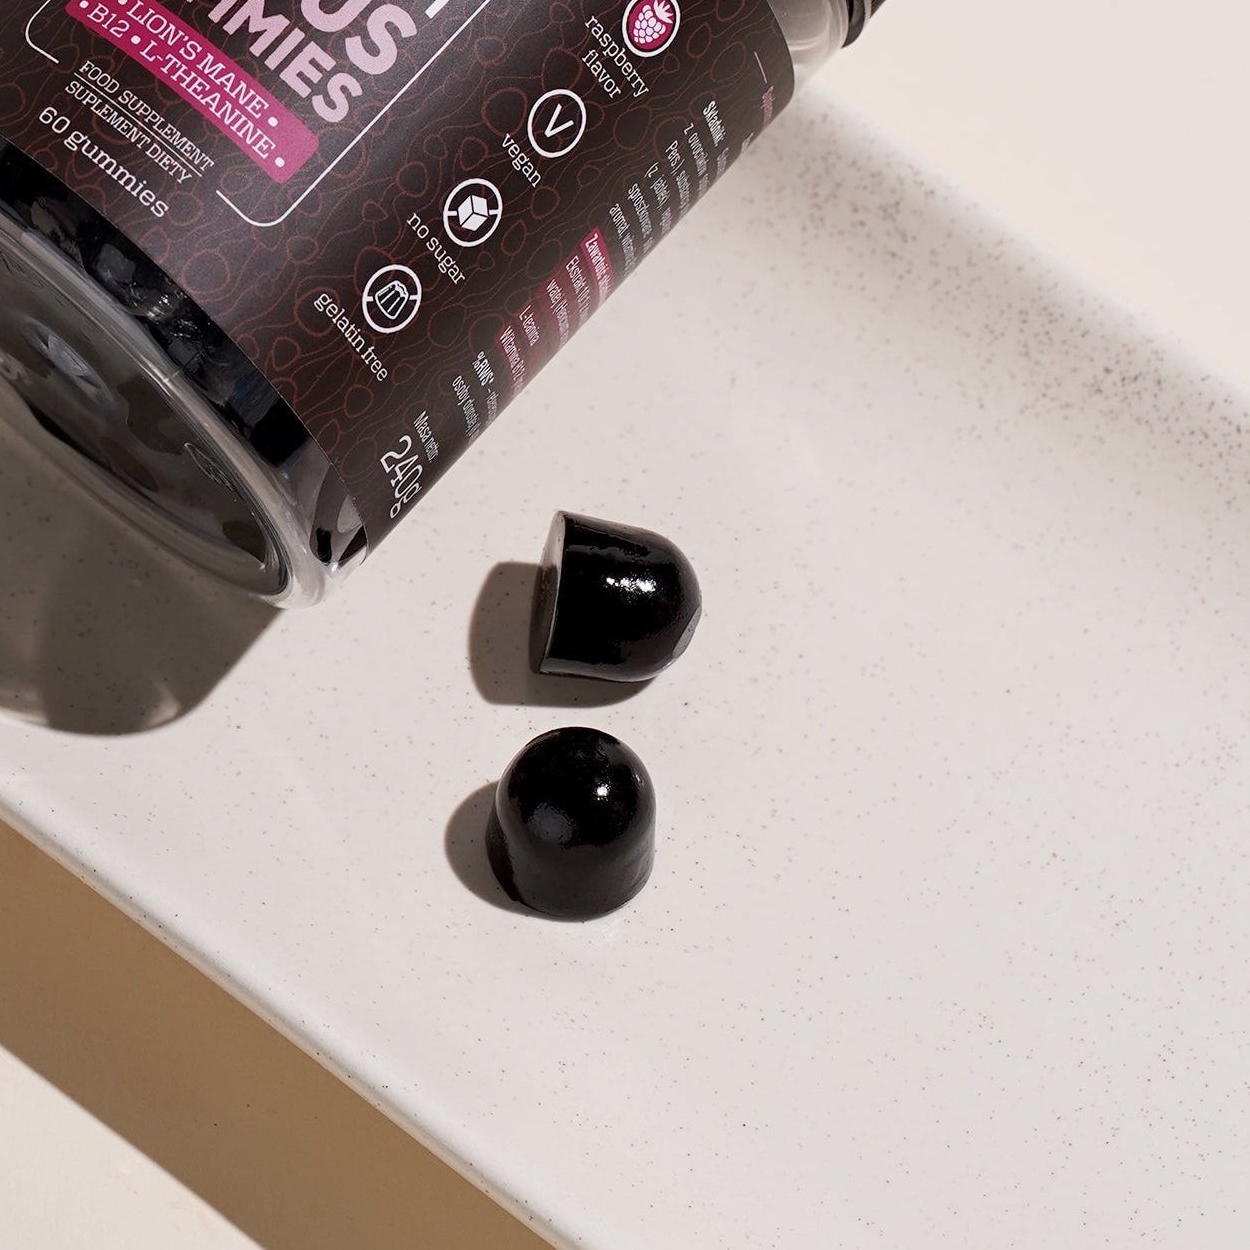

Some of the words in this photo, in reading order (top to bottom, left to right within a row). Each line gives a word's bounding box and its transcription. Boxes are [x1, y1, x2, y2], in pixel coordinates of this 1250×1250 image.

[87, 3, 130, 38] B12
[139, 40, 277, 159] L-THEANINE
[126, 0, 203, 61] LION'S
[196, 53, 270, 119] MANE
[582, 49, 622, 99] flavor
[584, 15, 649, 99] raspberry
[64, 80, 151, 149] SUPLEMENT
[147, 143, 193, 185] DIETY
[79, 61, 120, 94] FOOD
[118, 90, 215, 172] SUPPLEMENT
[501, 133, 543, 188] vegan
[39, 106, 71, 134] 60
[63, 130, 169, 218] gummies
[407, 213, 429, 240] no
[425, 234, 466, 285] sugar
[313, 293, 367, 352] gelatin
[360, 338, 389, 382] free
[380, 435, 423, 518] 240g
